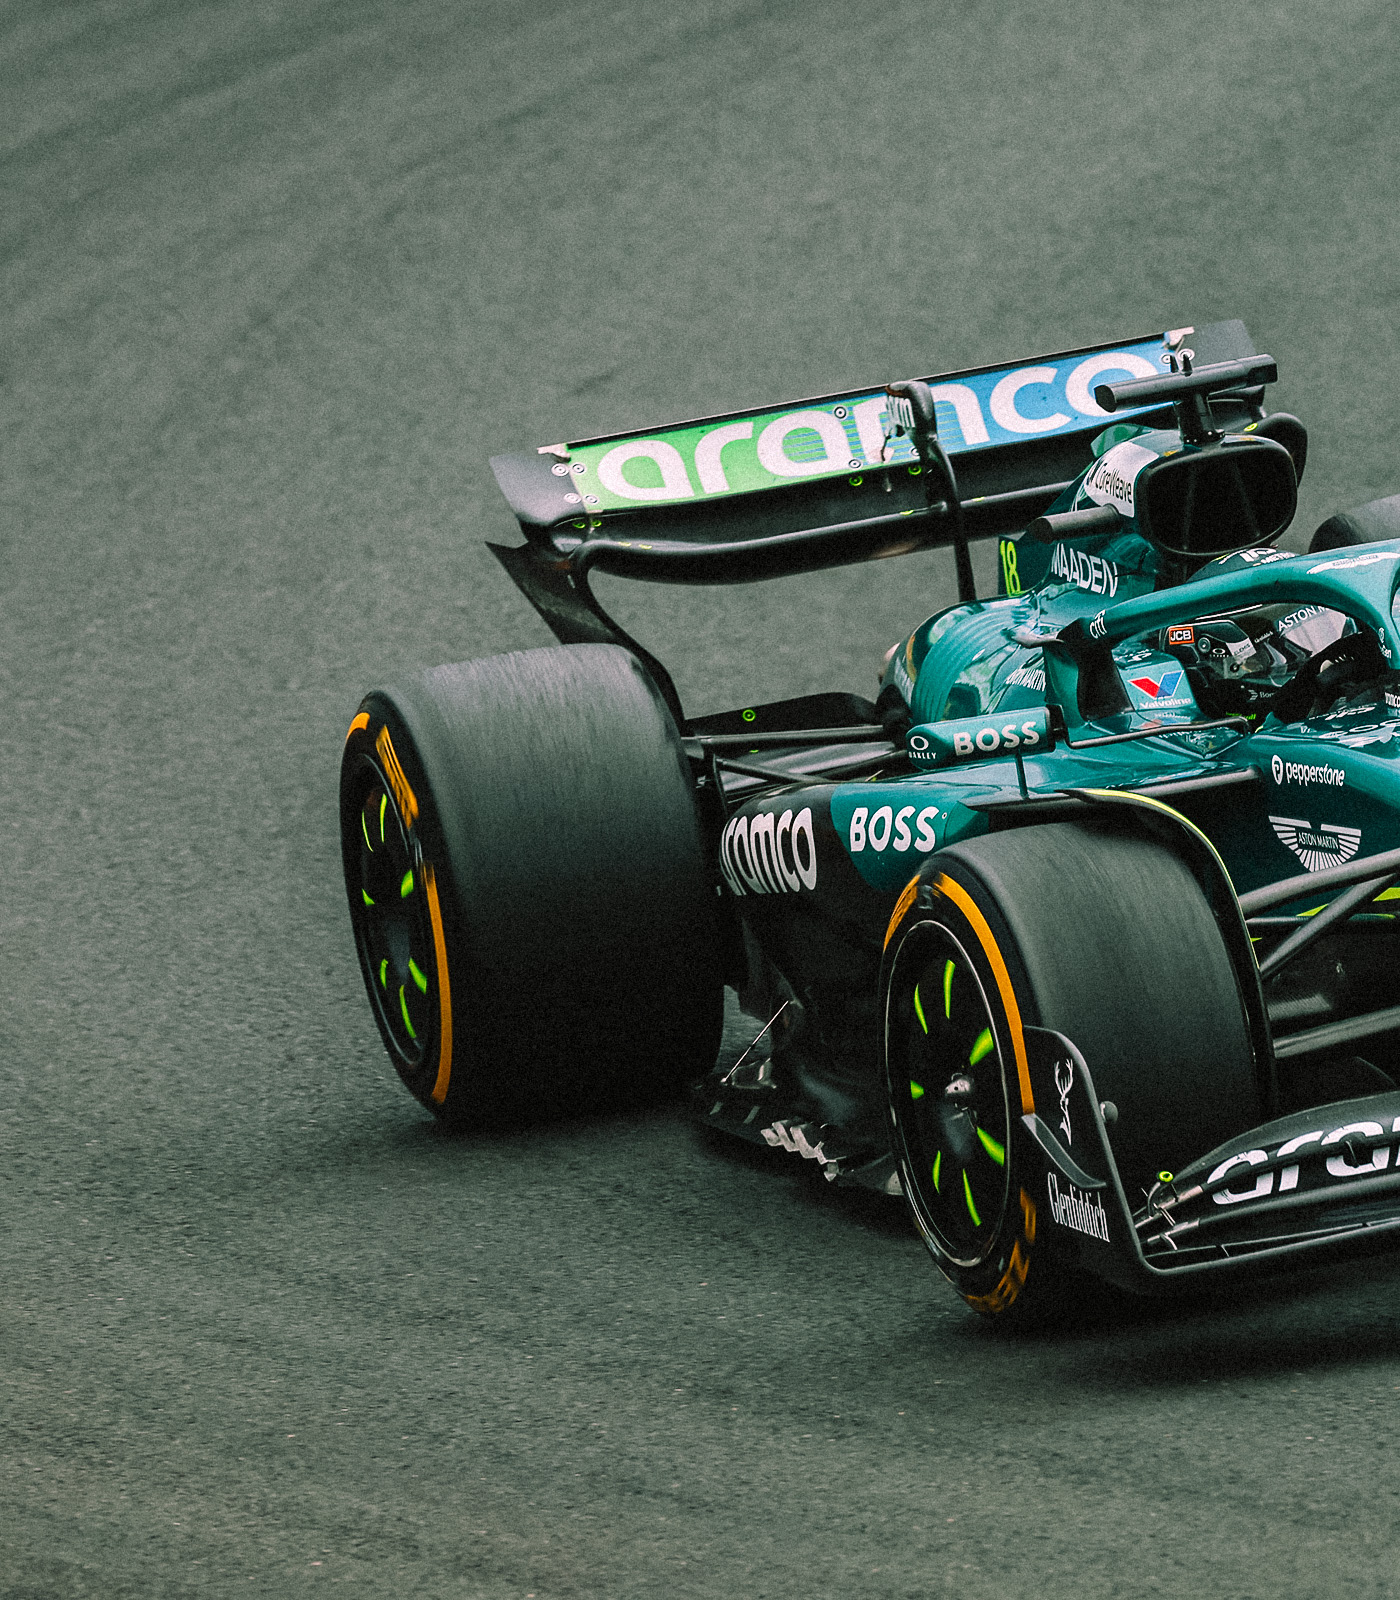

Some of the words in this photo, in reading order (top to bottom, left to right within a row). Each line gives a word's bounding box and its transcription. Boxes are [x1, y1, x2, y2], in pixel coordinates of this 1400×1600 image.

[597, 353, 1159, 502] aramco
[999, 540, 1022, 597] 18
[1278, 605, 1317, 632] ASTON
[1171, 628, 1192, 642] JCB
[1139, 697, 1194, 709] Valvoline
[953, 720, 1040, 756] BOSS
[908, 751, 938, 761] OAKLEY
[1285, 761, 1346, 787] pepperstone
[849, 805, 940, 853] BOSS
[1298, 831, 1317, 846] ASTON
[1316, 834, 1339, 849] MARTIN
[1047, 1171, 1111, 1243] Glenfiddich
